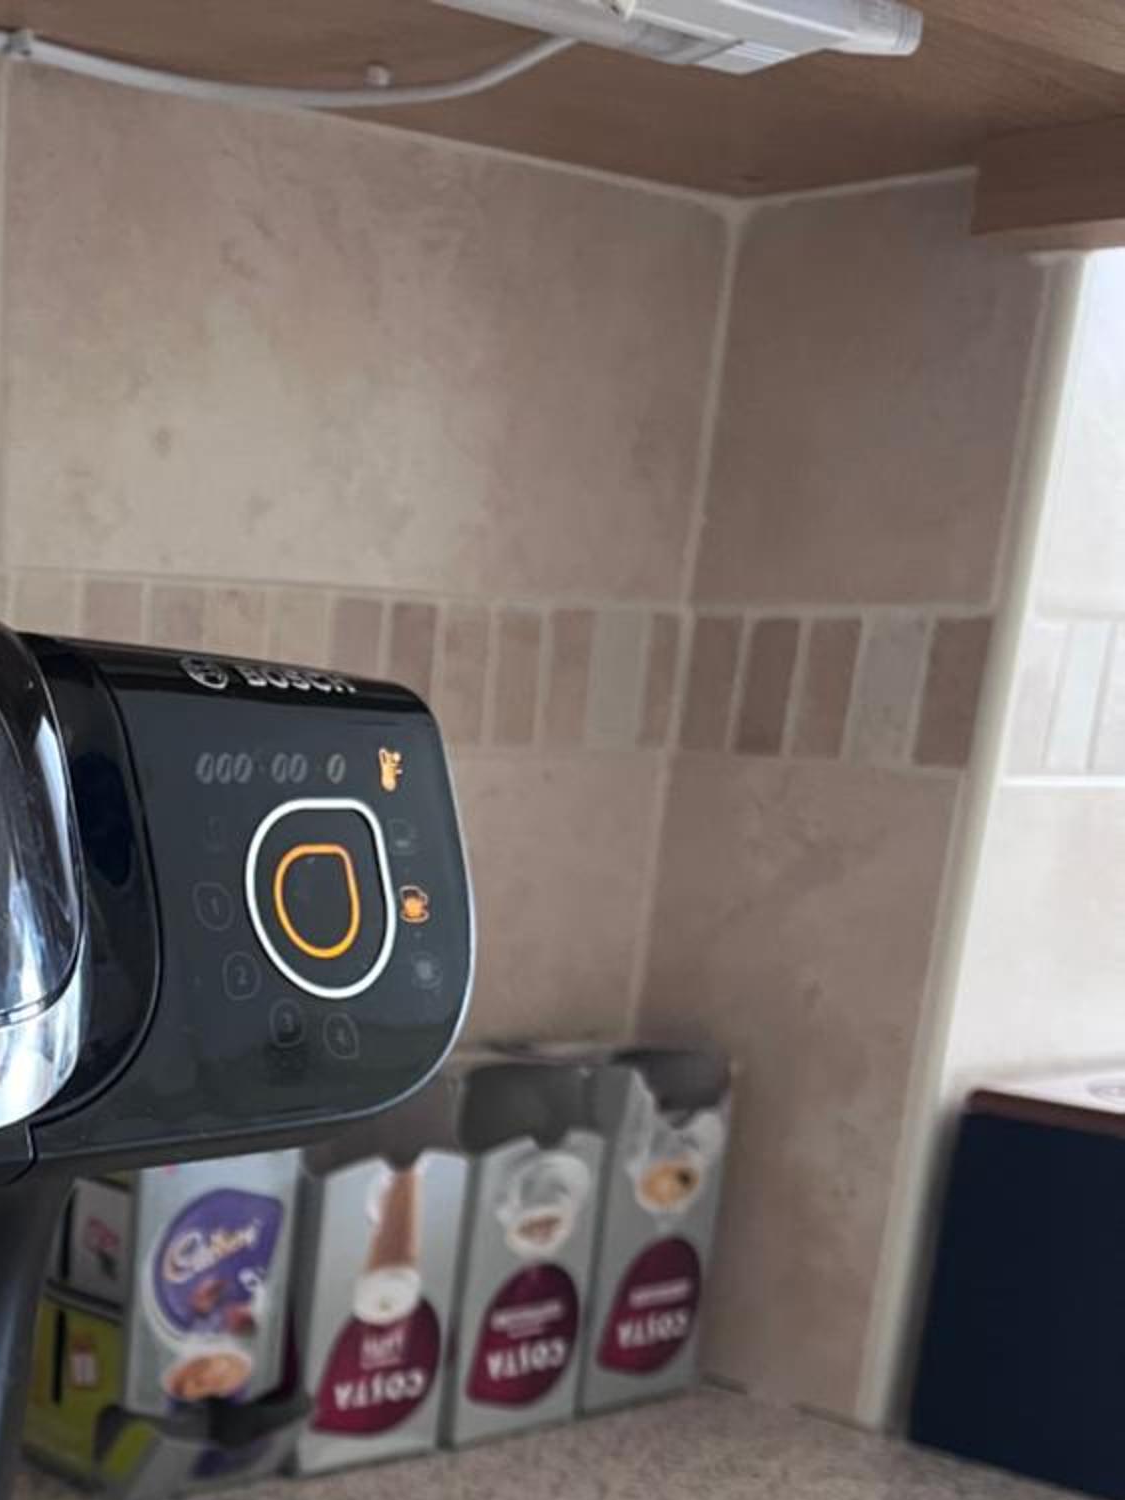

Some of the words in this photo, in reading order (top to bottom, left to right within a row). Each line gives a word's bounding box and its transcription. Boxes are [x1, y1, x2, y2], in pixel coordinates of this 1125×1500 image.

[235, 663, 358, 695] BOSCH
[616, 1309, 690, 1349] COSTA
[485, 1338, 566, 1381] COSTA
[333, 1370, 426, 1411] COSTA
